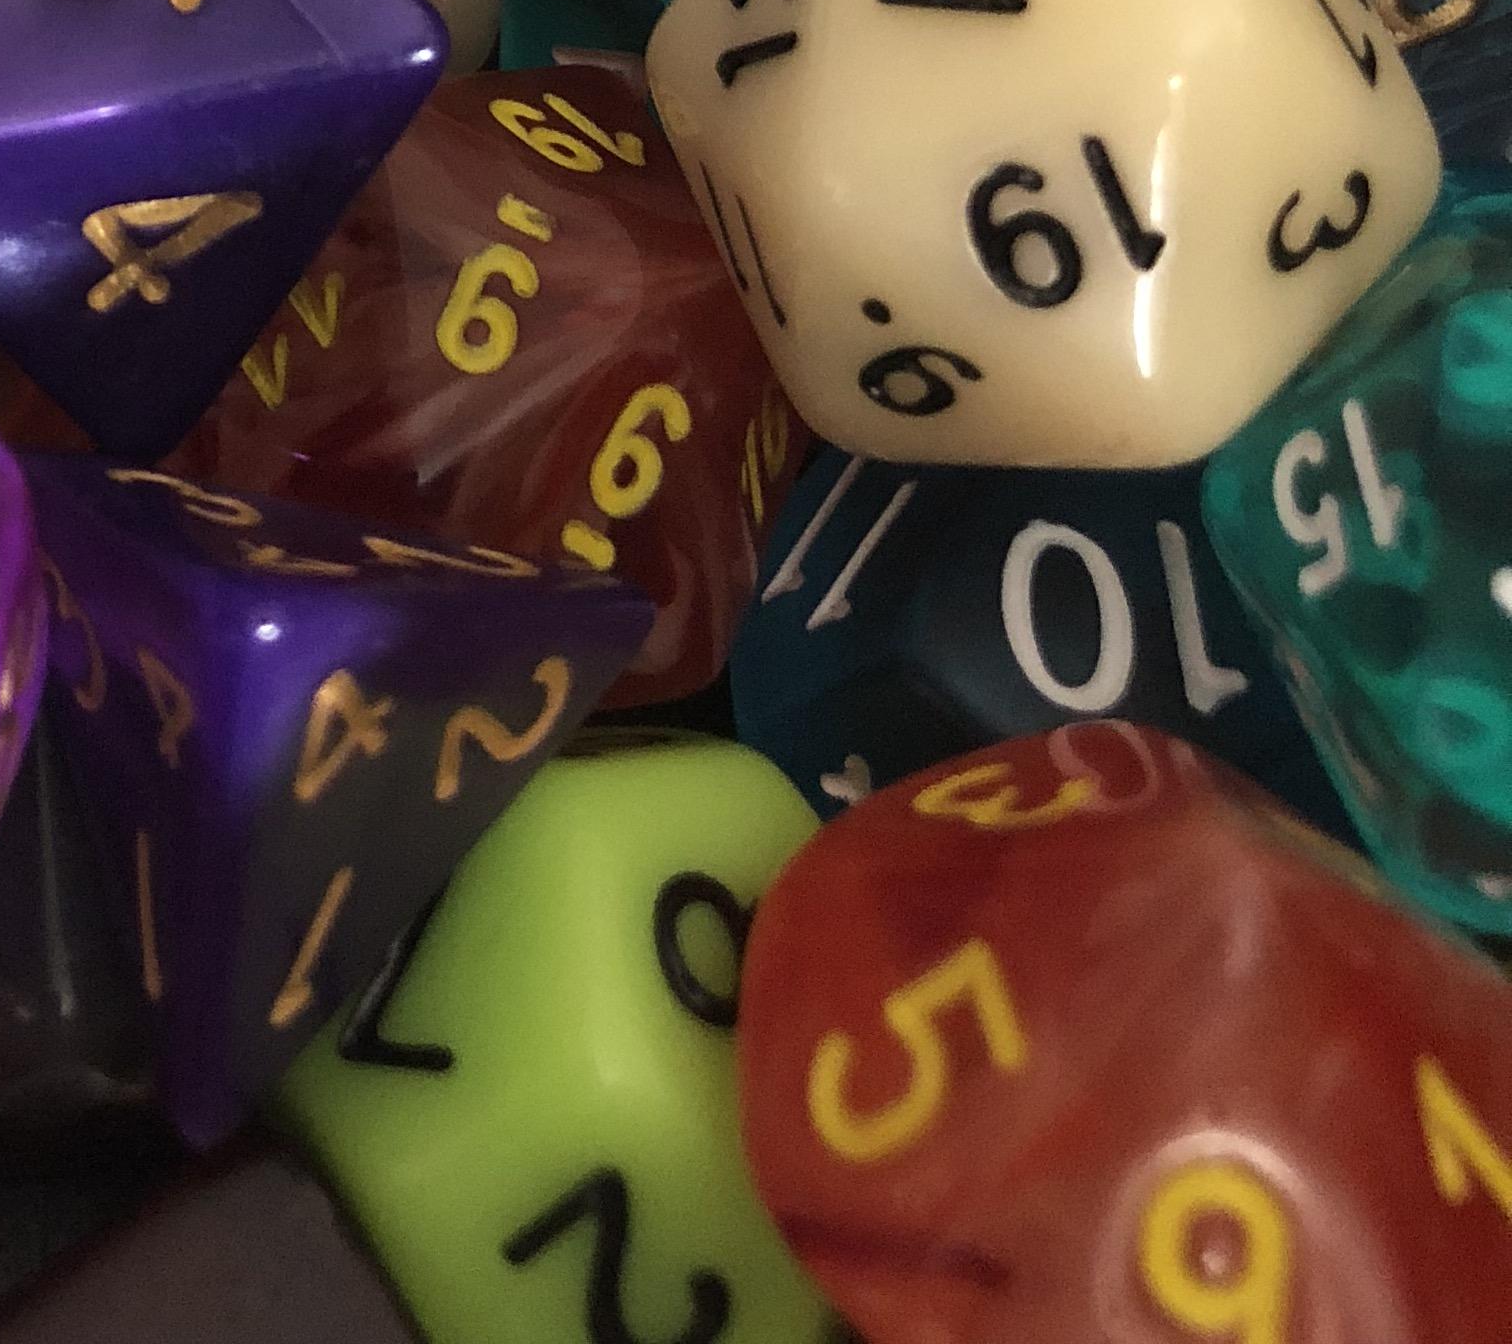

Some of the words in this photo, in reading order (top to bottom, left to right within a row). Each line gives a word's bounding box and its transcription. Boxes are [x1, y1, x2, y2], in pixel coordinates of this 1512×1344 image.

[83, 192, 264, 312] 4
[965, 134, 1168, 310] 19
[1266, 169, 1372, 274] 3
[1275, 402, 1408, 597] 15
[1001, 518, 1250, 714] 10
[295, 670, 398, 804] 4
[433, 655, 570, 801] 2
[268, 865, 356, 1026] 1
[336, 890, 455, 1072] 7
[806, 935, 1030, 1164] 5
[501, 1165, 730, 1344] 2
